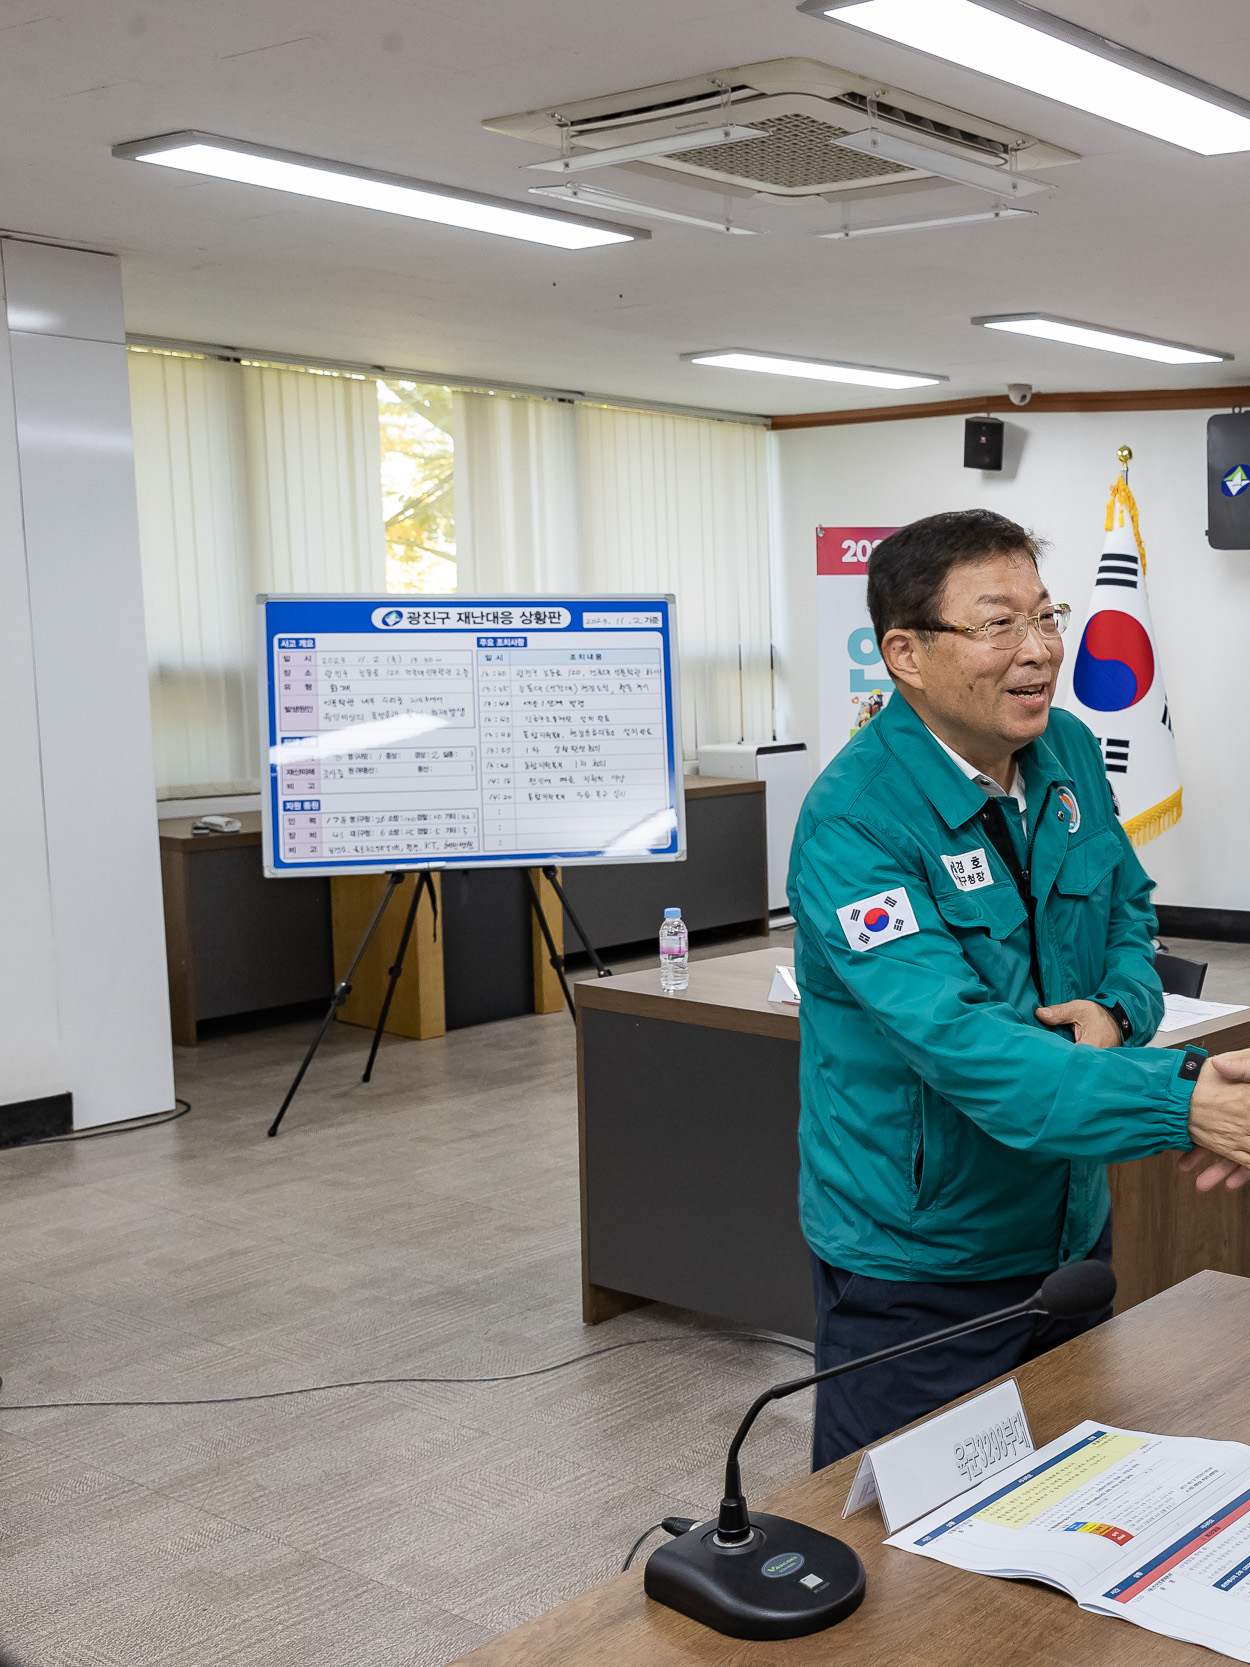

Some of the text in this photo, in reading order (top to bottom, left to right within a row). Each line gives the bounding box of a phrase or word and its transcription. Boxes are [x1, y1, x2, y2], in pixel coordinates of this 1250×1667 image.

[841, 539, 883, 563] 20
[407, 611, 561, 625] 광진구 재난대응 상황판
